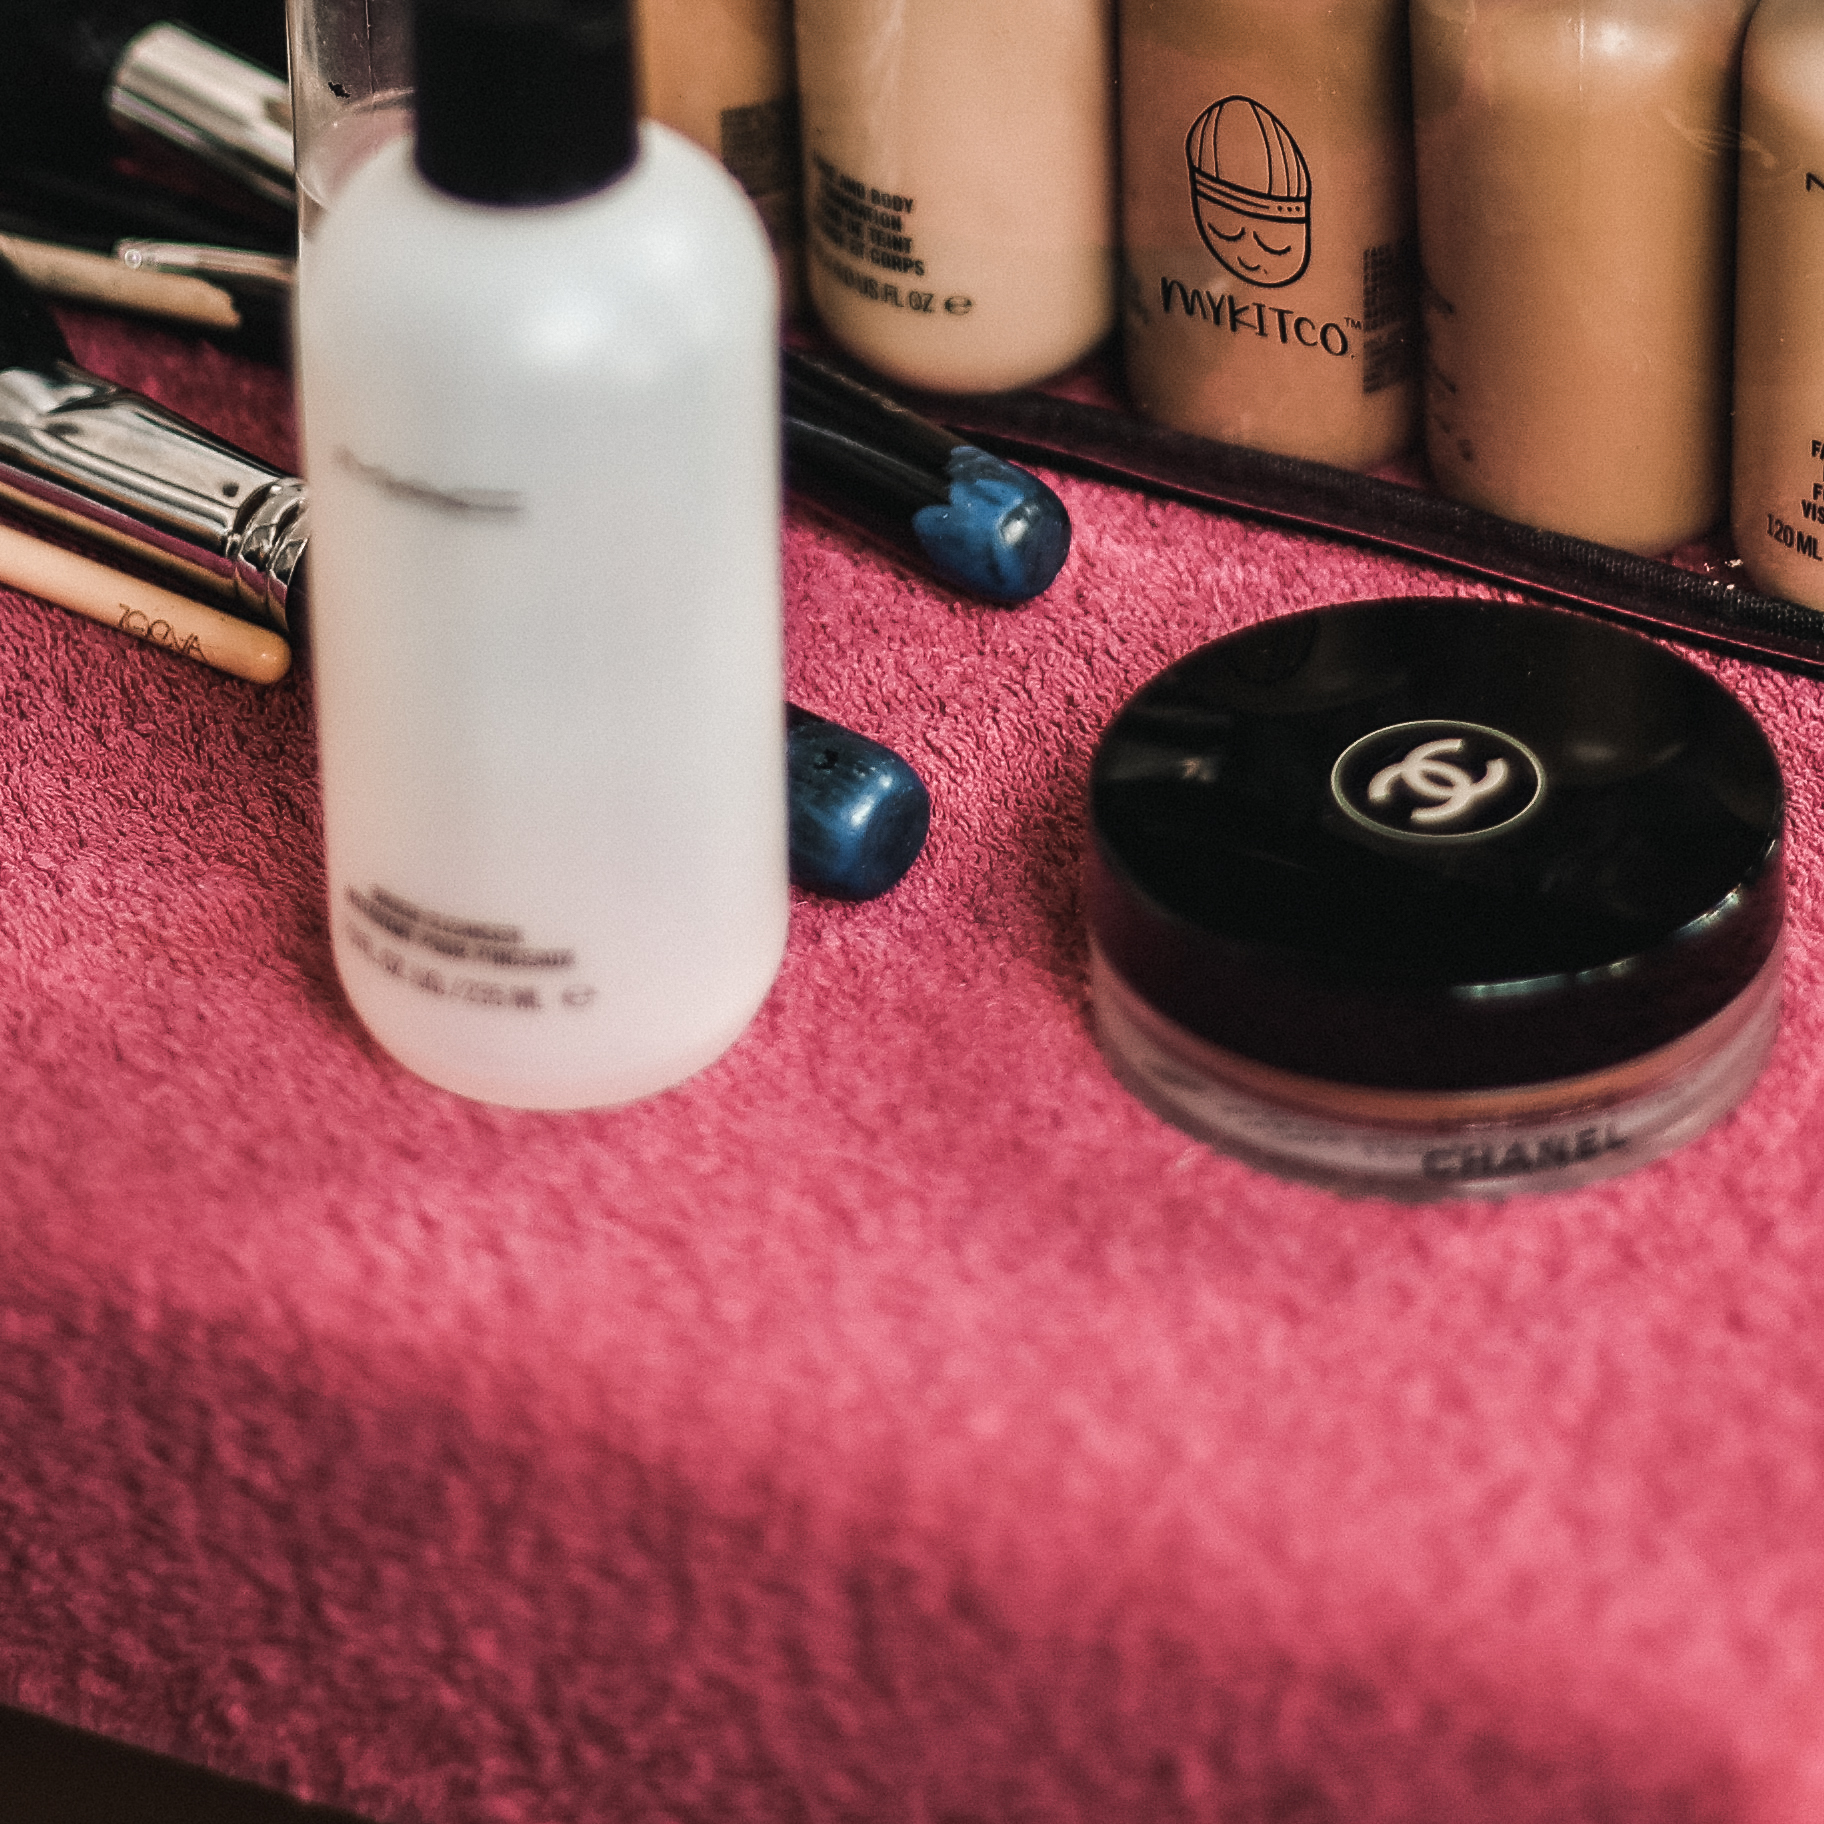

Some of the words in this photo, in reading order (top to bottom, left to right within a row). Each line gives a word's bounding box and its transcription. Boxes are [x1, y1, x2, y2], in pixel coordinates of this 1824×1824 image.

[908, 290, 935, 314] OZ
[1765, 512, 1795, 549] 120
[1795, 530, 1823, 562] ML
[1421, 1125, 1631, 1180] CHANEL
